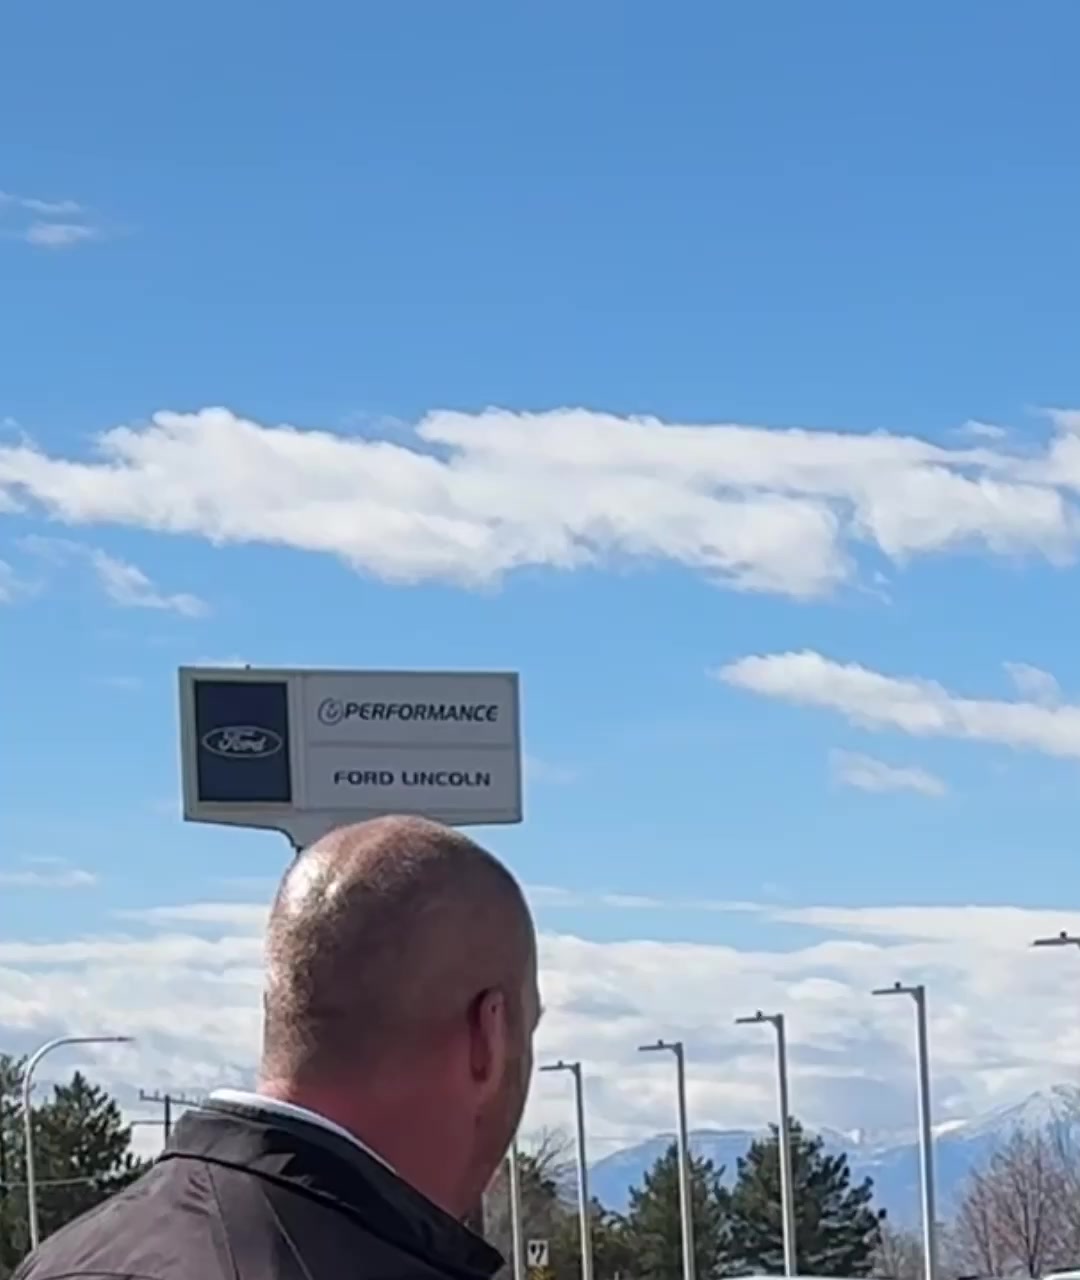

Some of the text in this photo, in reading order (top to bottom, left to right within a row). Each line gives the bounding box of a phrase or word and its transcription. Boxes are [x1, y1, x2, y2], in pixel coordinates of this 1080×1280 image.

[344, 702, 499, 723] PERFORMANCE
[217, 727, 268, 752] Ford
[333, 770, 491, 787] FORD LINCOLN
